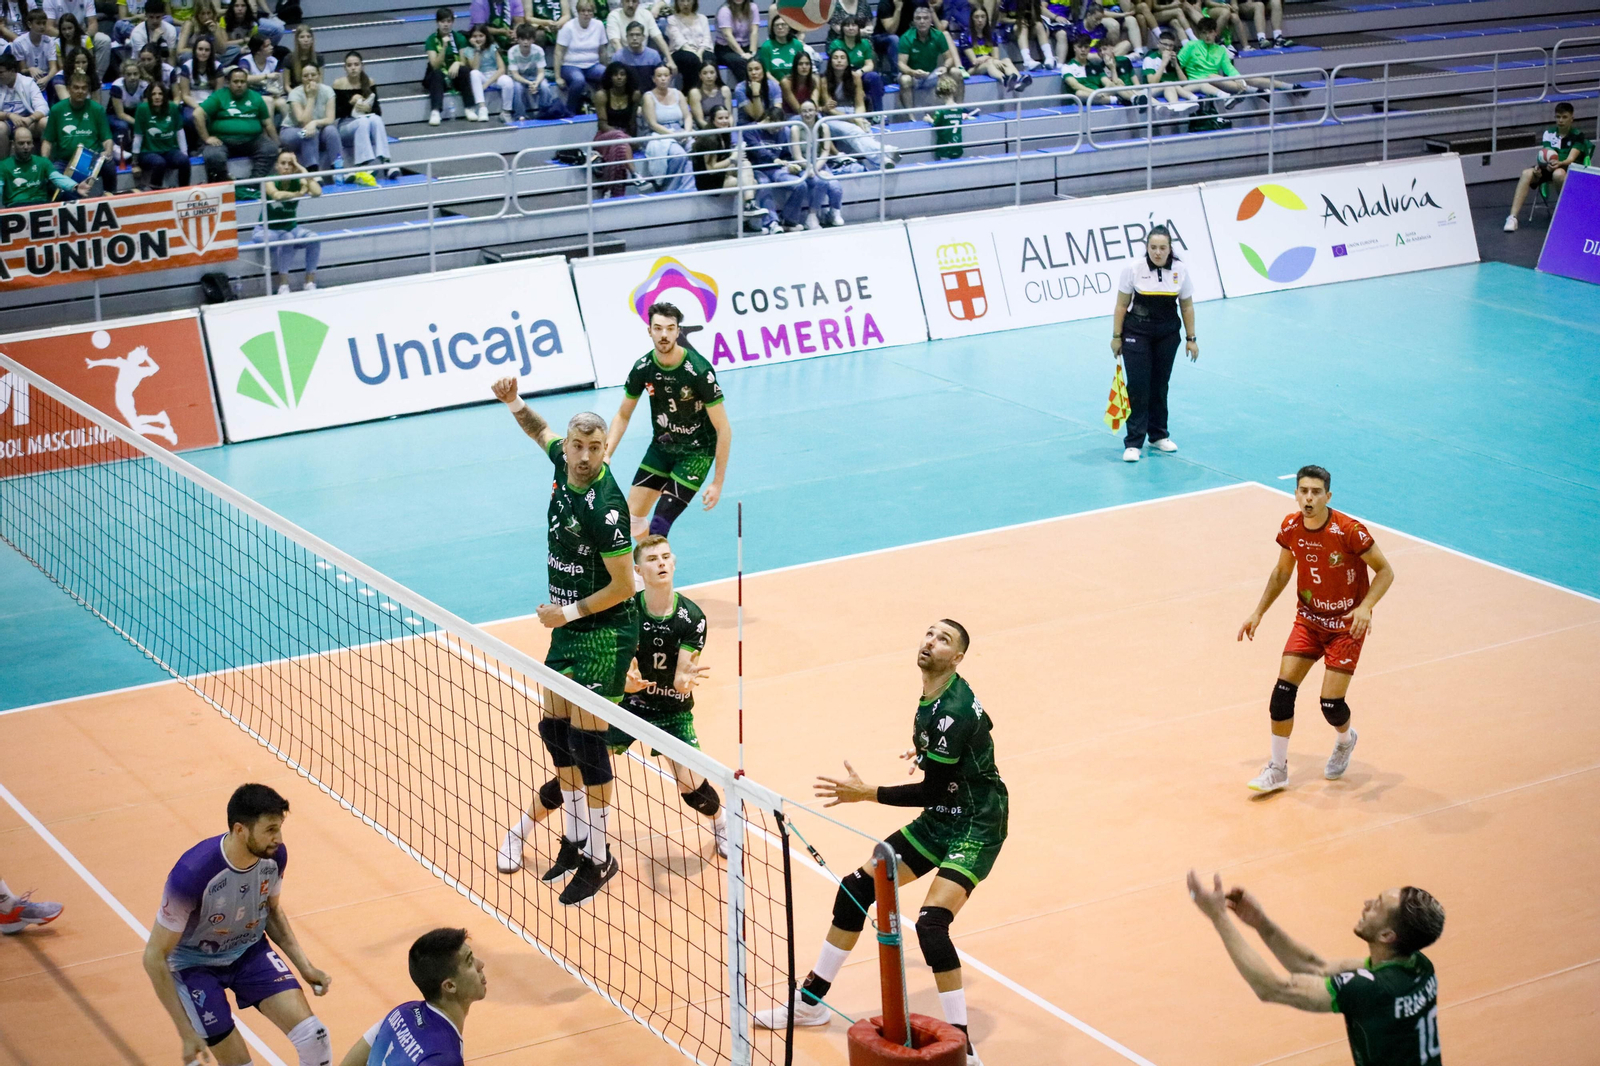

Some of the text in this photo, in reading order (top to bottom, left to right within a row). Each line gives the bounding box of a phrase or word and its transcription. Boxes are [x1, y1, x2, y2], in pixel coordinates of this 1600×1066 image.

[949, 119, 960, 134] 7
[180, 210, 190, 218] LA
[1320, 177, 1443, 229] Andalucía
[0, 198, 120, 244] PEÑA
[26, 229, 168, 276] UNION
[731, 275, 873, 316] COSTA DE
[1024, 272, 1112, 304] CIUDAD
[347, 310, 564, 386] Unicaja
[712, 305, 885, 366] ALMERÍA
[667, 398, 678, 413] 3
[1309, 567, 1322, 585] 5
[567, 589, 579, 599] DE
[1312, 597, 1355, 611] Unicaja
[652, 652, 668, 670] 12
[266, 950, 289, 973] 6
[1394, 989, 1427, 1019] FRAN
